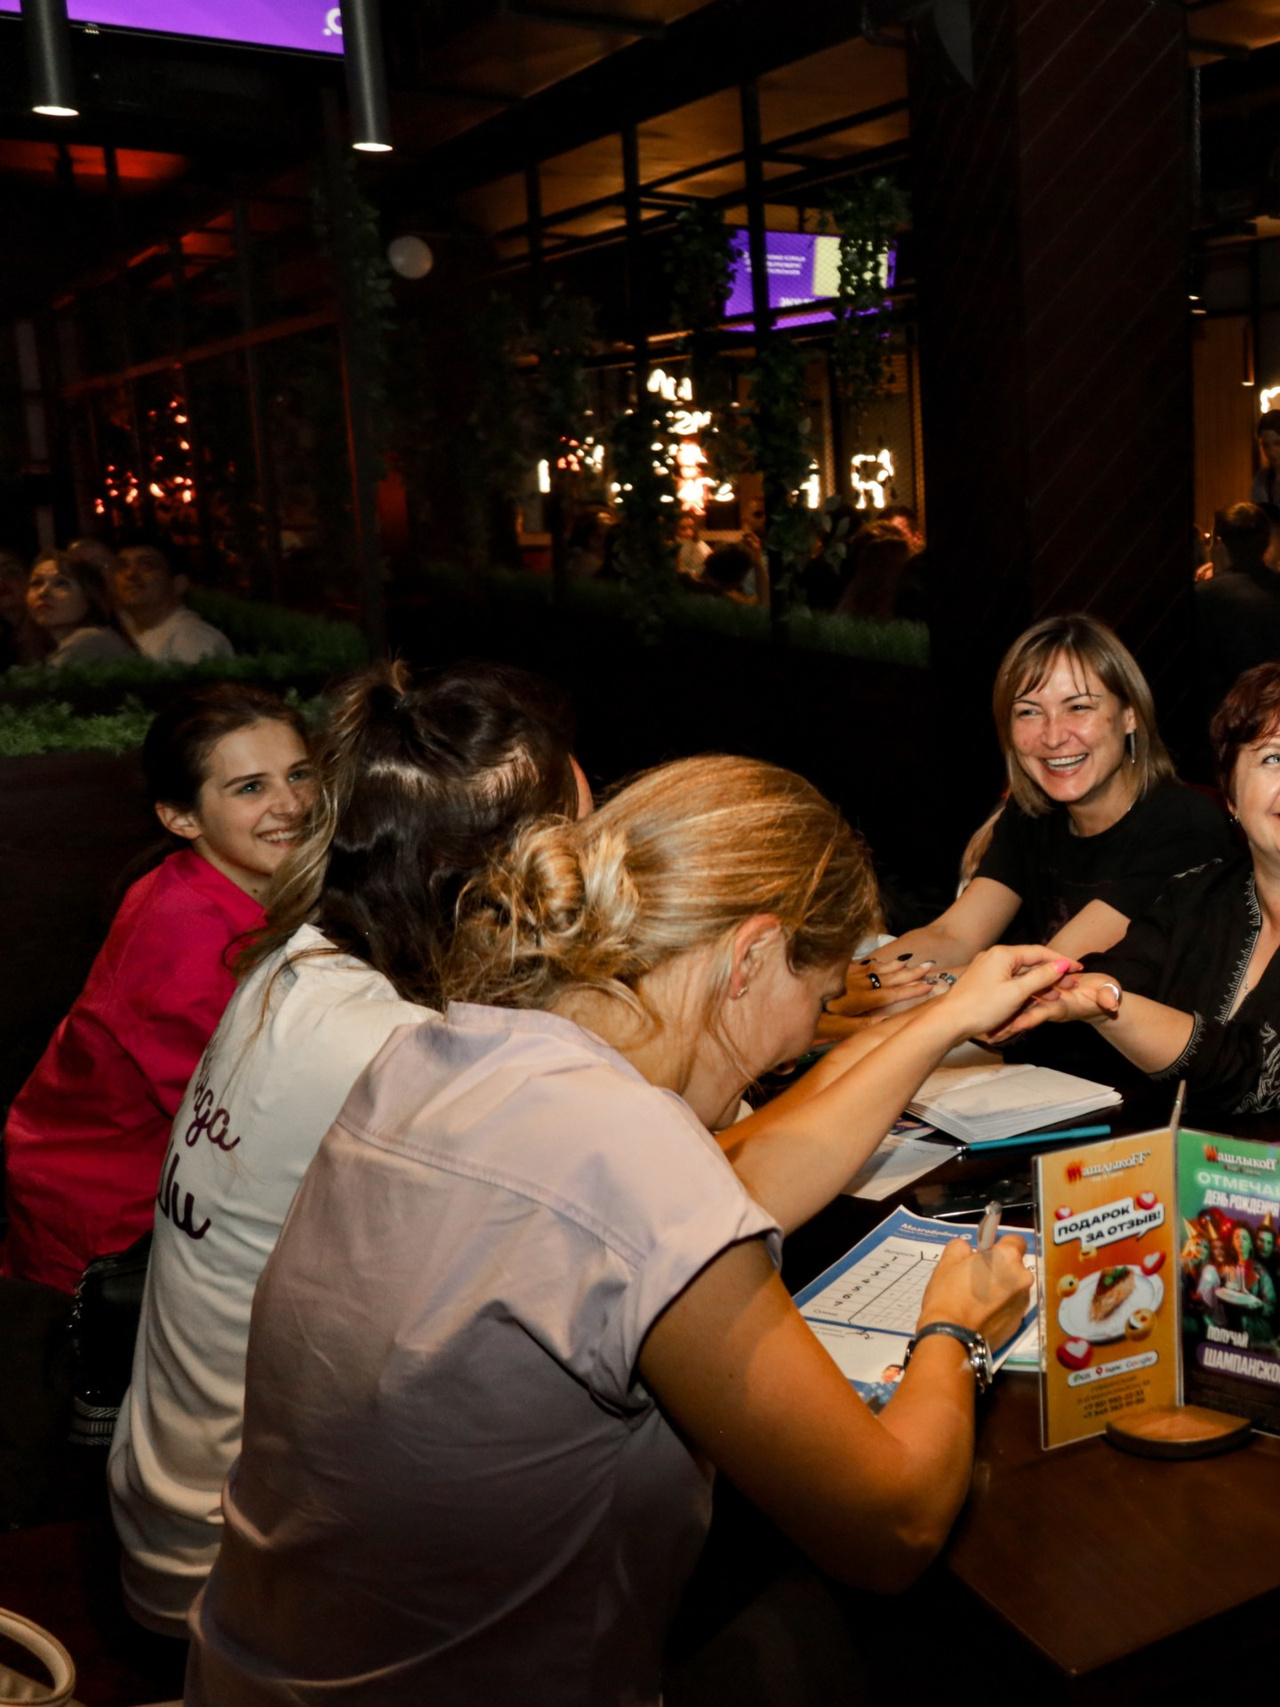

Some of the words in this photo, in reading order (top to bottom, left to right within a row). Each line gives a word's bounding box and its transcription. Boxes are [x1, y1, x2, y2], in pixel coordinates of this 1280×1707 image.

[1204, 1189, 1229, 1207] ДЕНЬ
[1229, 1194, 1280, 1218] РОЖДЕНИЯ
[1058, 1205, 1130, 1236] ПОДАРОК
[1086, 1231, 1105, 1243] ЗА
[1107, 1211, 1161, 1235] ОТЗЫВ!
[1207, 1325, 1249, 1348] ПОЛУЧАЙ
